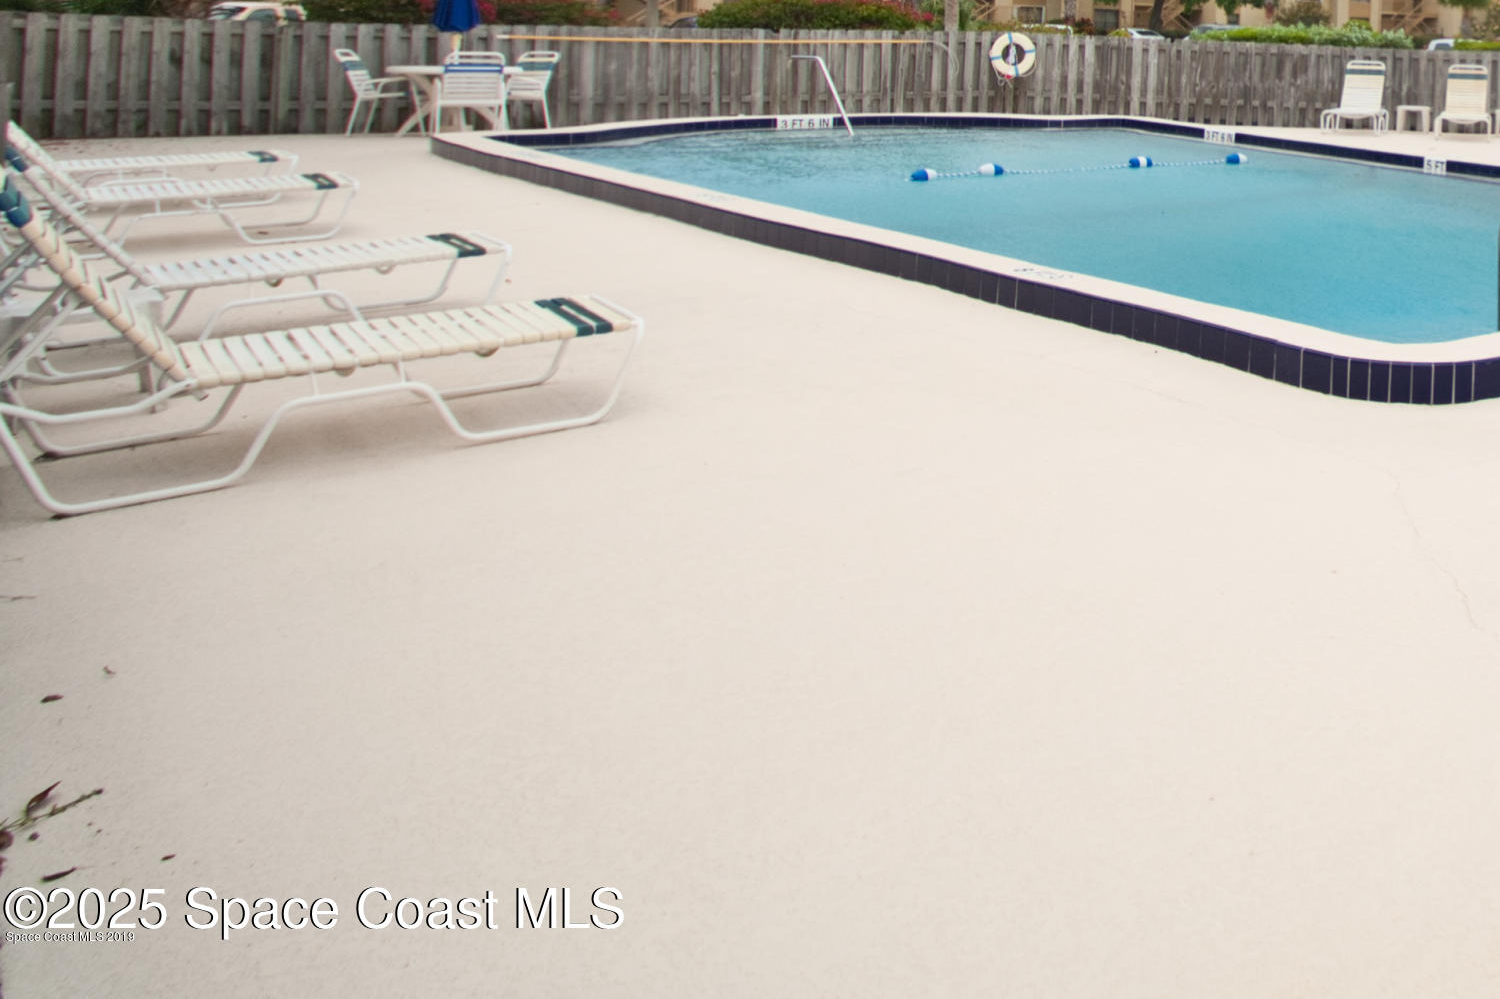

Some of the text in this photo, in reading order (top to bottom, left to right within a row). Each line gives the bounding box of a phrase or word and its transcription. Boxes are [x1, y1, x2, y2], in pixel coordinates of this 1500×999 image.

[792, 119, 804, 129] FT
[819, 118, 830, 129] IN
[1435, 161, 1445, 172] FT
